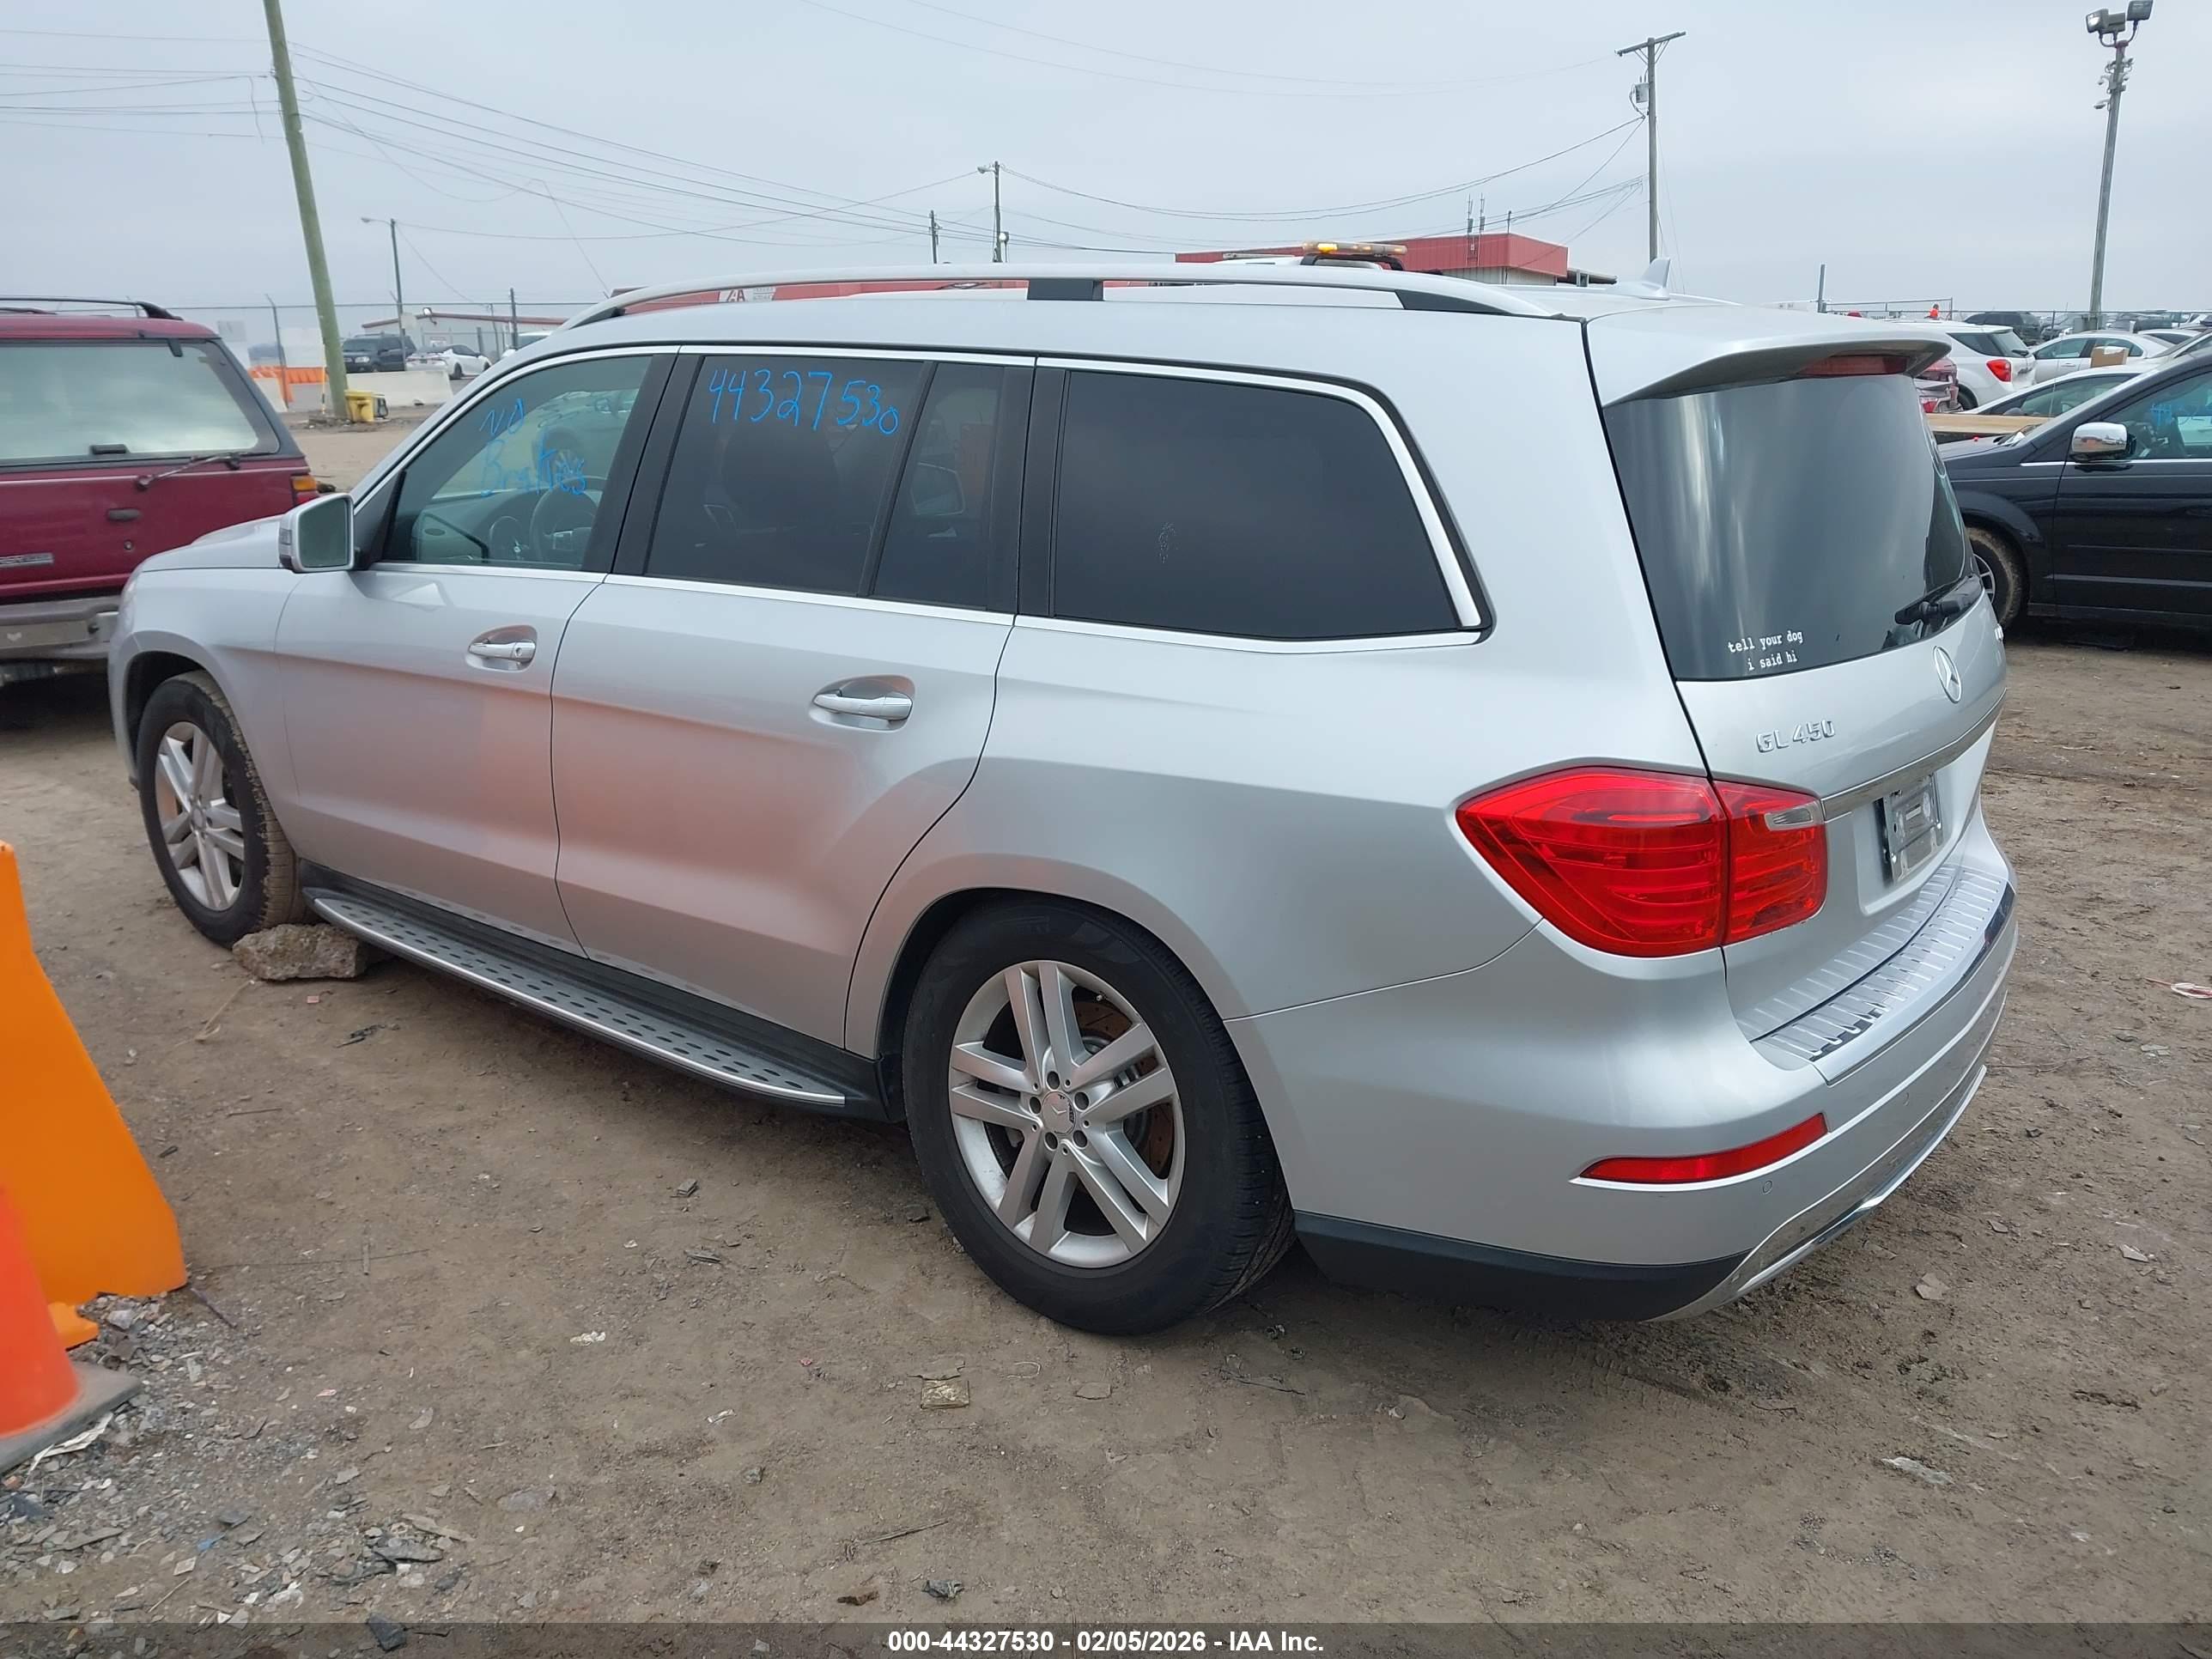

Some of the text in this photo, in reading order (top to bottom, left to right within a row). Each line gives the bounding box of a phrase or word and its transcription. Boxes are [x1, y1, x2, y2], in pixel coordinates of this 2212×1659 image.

[709, 369, 898, 434] 44327530
[1728, 629, 1803, 653] tell your dog
[1747, 649, 1798, 671] i said hi
[1756, 719, 1836, 753] GL 450
